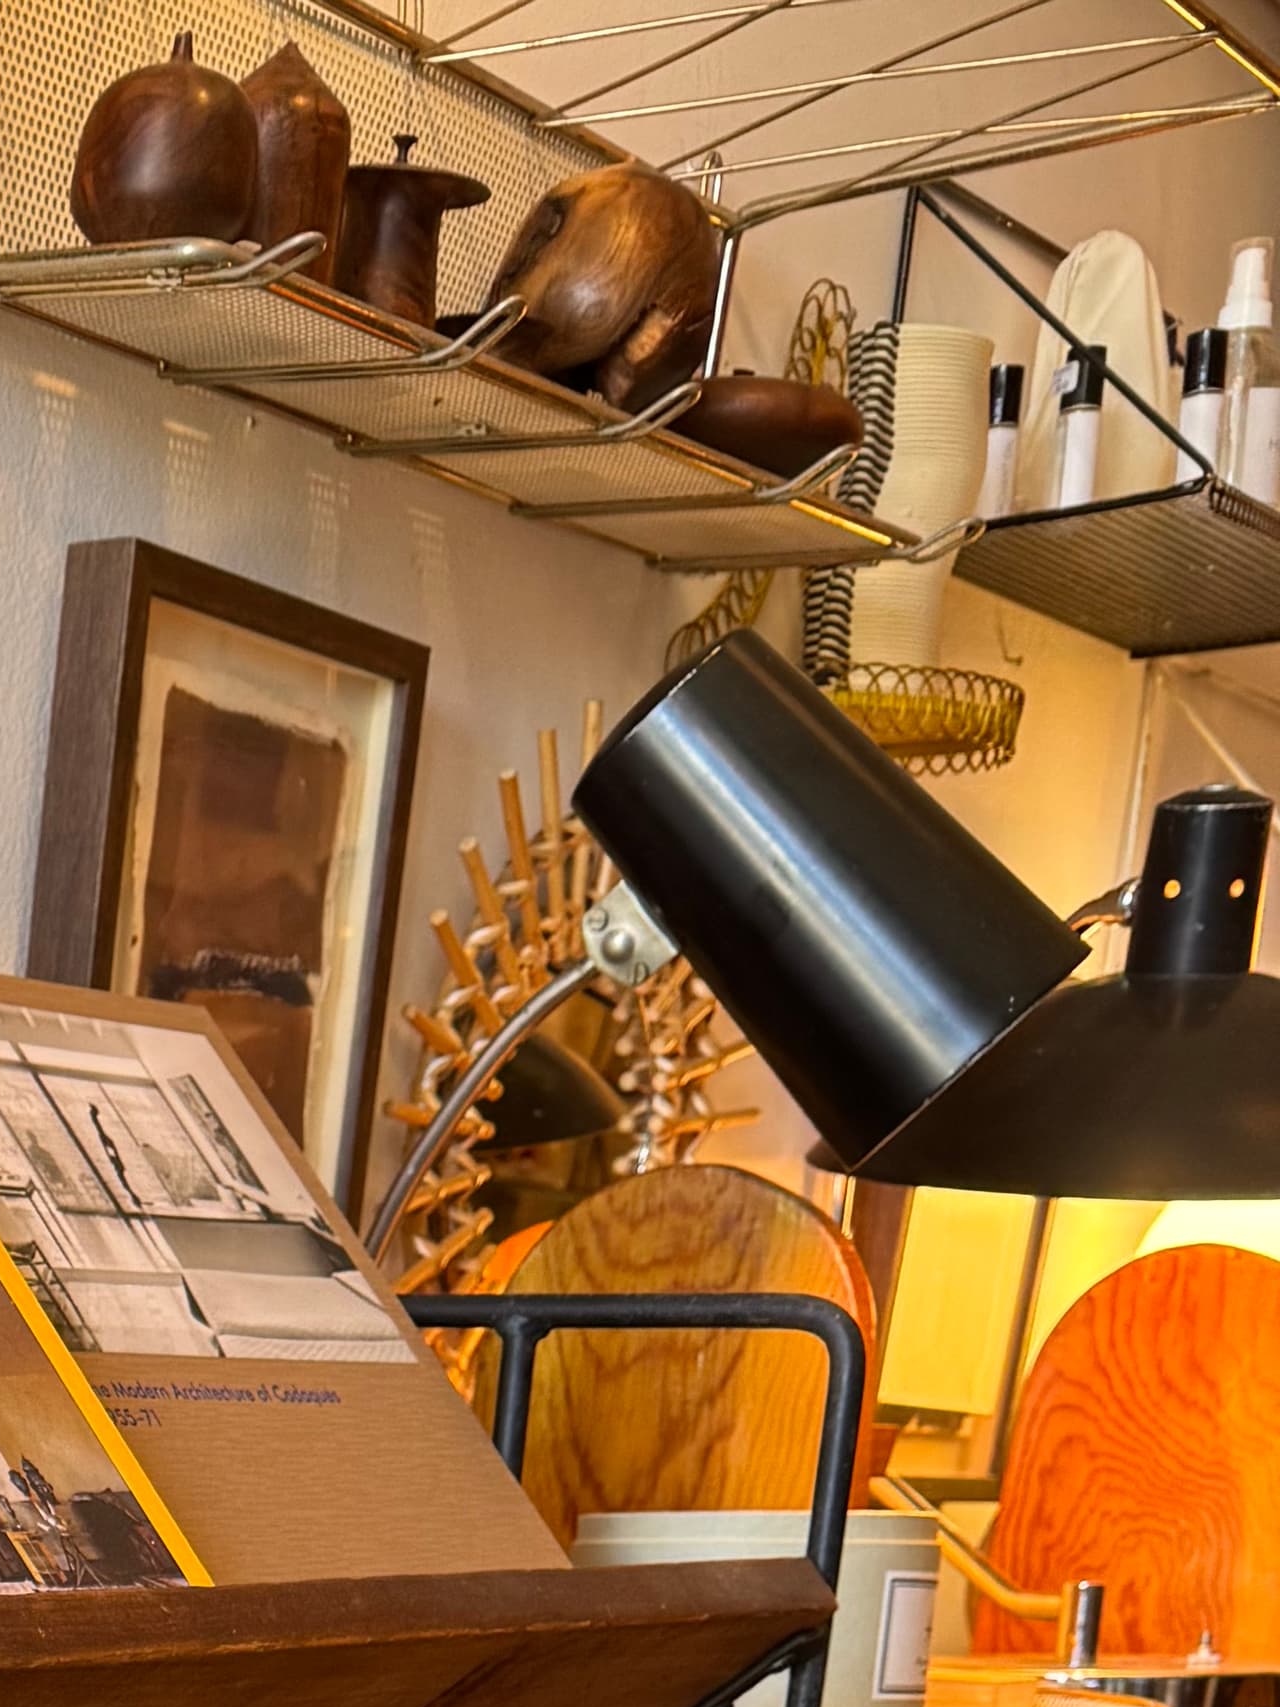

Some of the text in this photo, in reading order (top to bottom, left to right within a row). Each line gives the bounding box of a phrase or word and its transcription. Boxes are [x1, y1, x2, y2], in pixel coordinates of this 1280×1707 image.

[111, 1380, 170, 1399] Modern
[171, 1382, 255, 1402] Architecture
[257, 1384, 272, 1402] of
[106, 1408, 162, 1427] 955-71
